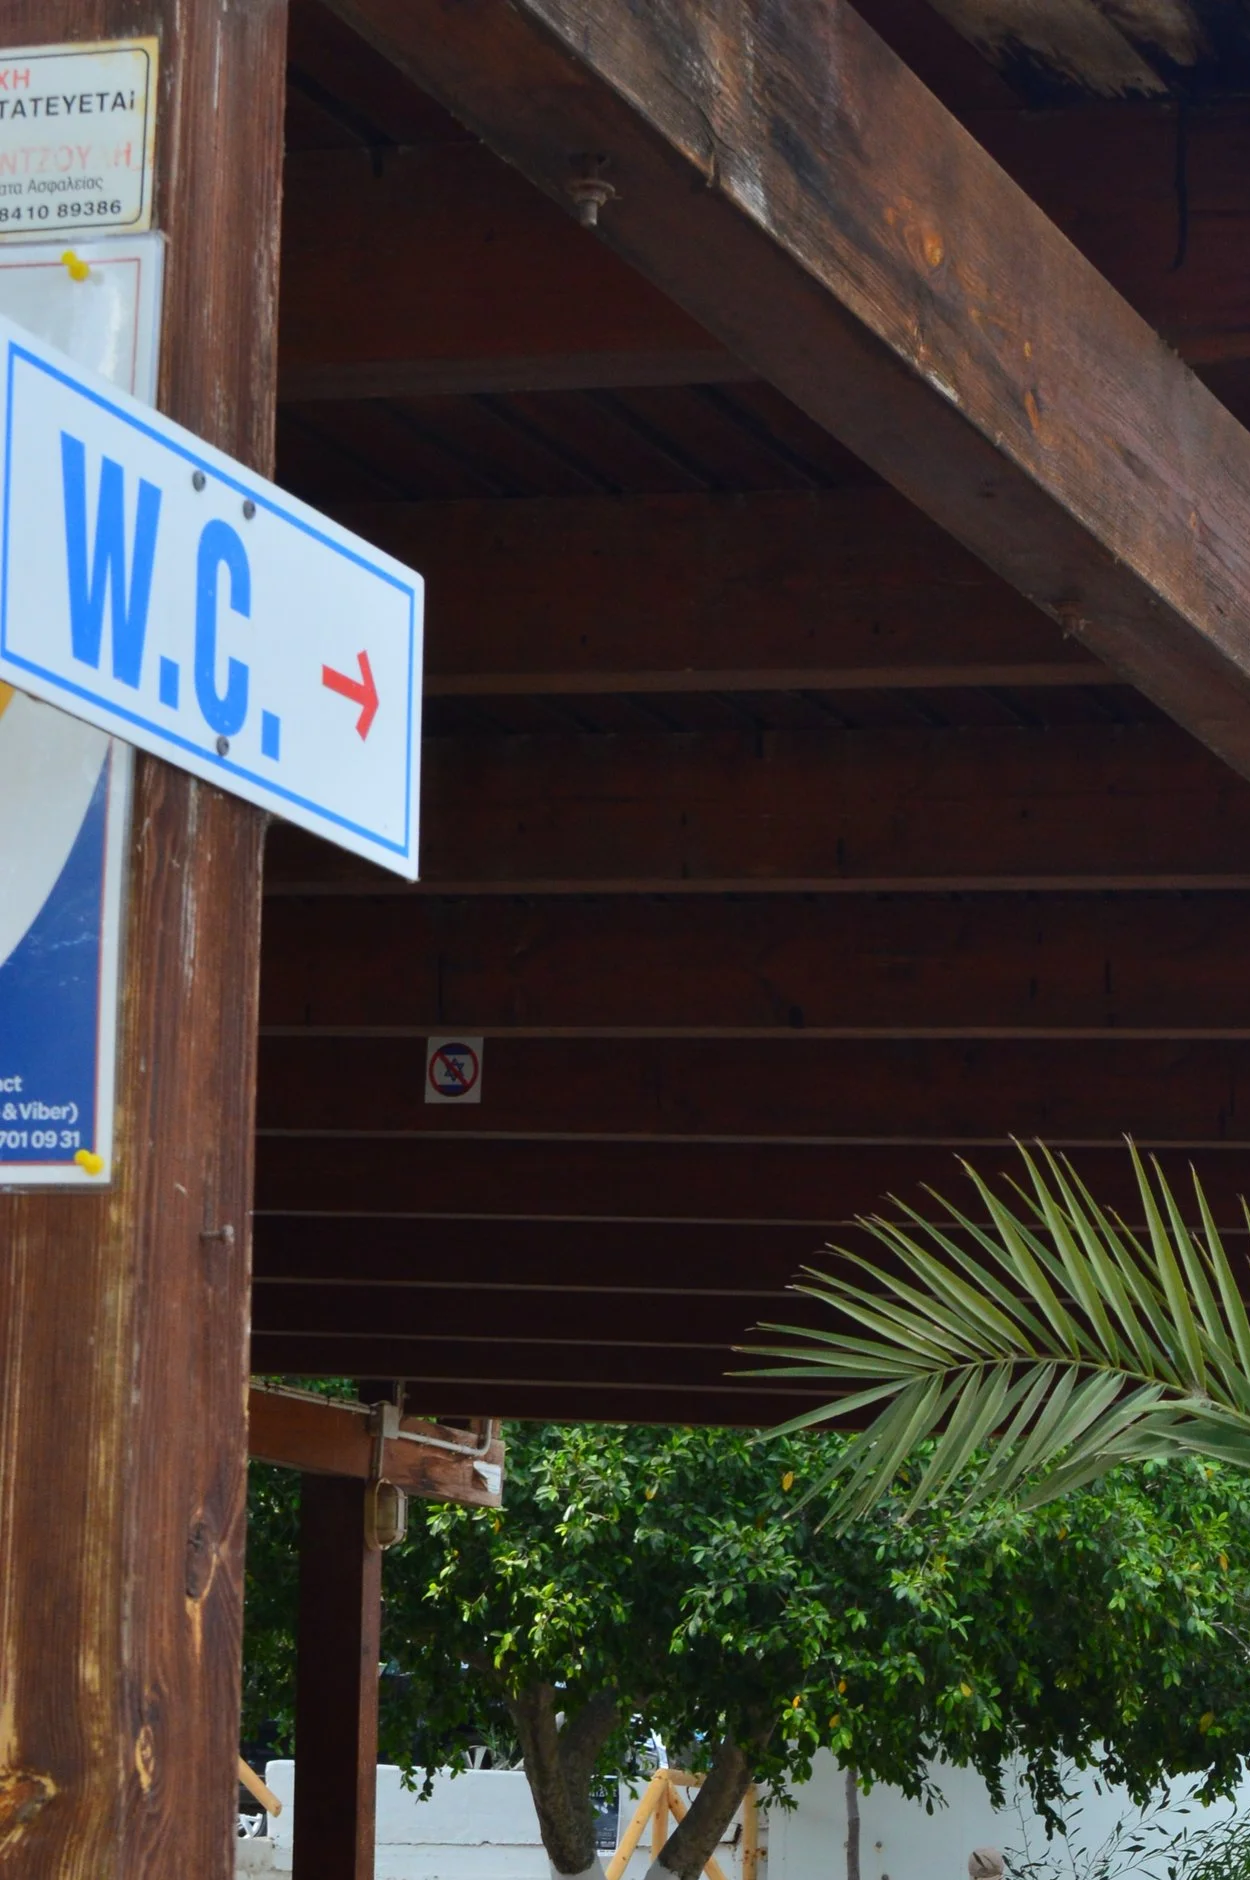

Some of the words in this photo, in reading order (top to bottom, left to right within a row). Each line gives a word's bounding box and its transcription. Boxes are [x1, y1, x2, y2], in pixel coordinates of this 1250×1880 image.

[57, 199, 122, 218] 89386
[60, 429, 281, 763] W.C.
[2, 1102, 18, 1121] &
[19, 1101, 79, 1124] Viber)
[31, 1130, 57, 1149] 09
[59, 1130, 80, 1149] 31
